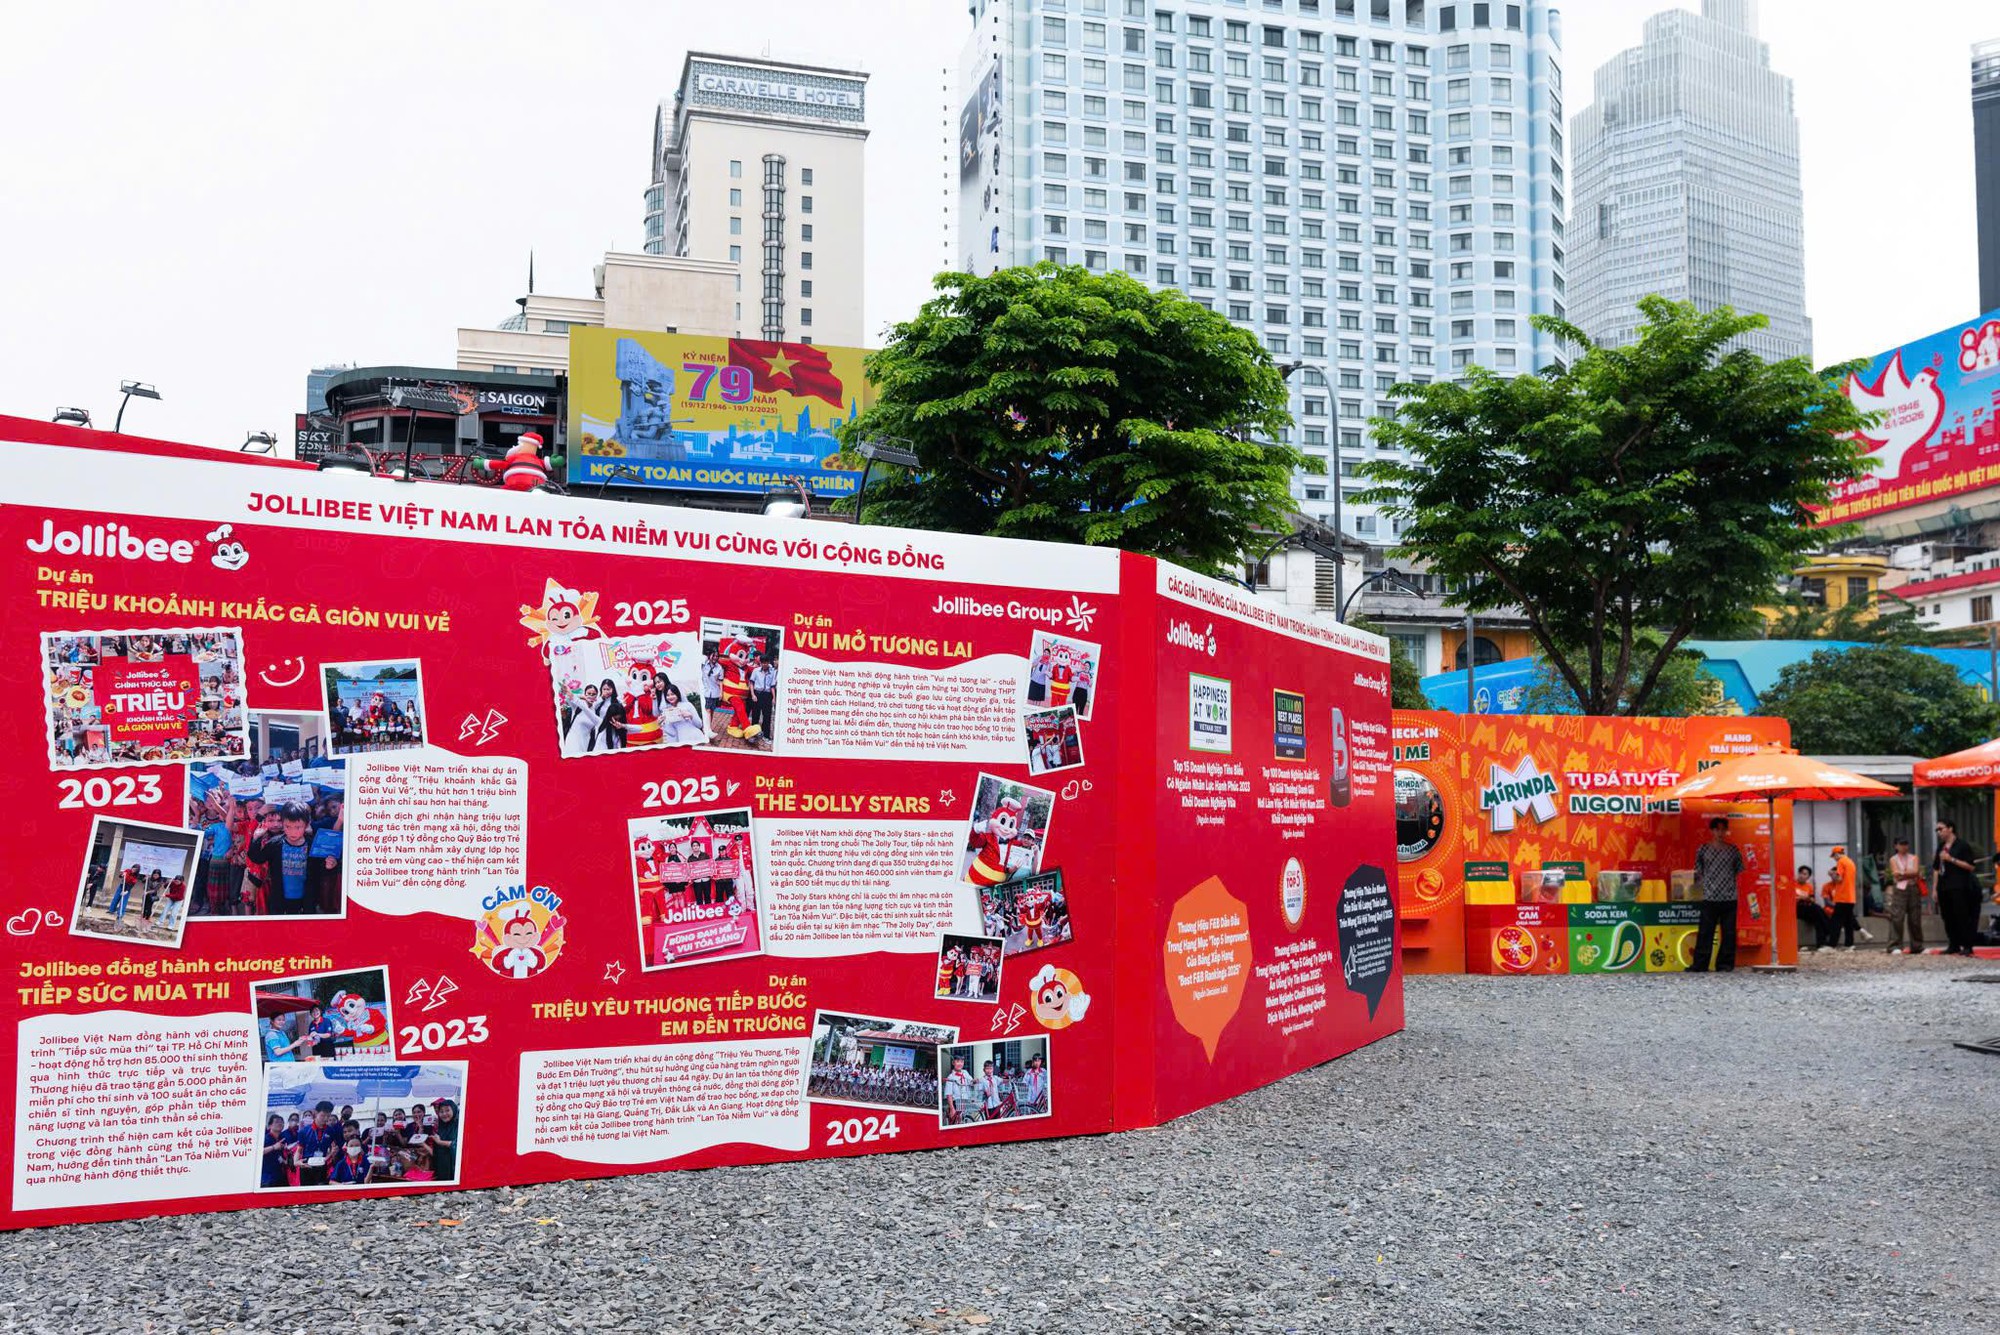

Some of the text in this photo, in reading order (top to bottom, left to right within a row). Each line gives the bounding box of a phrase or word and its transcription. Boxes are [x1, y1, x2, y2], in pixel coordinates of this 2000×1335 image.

[703, 77, 858, 107] CARAVELLE HOTEL
[699, 354, 726, 363] NIỆM
[683, 363, 754, 404] 79
[488, 392, 545, 407] SAIGON
[26, 519, 195, 564] Jollibee
[247, 492, 944, 570] JOLLIBEE VIỆT NAM LAN TỎA NIỀM VUI CÙNG VỚI CỘNG ĐỒNG
[38, 566, 93, 585] Dự án
[36, 588, 450, 632] TRIỆU KHOẢNH KHẮC GÀ GIÒN VUI VẺ
[614, 599, 690, 627] 2025
[932, 595, 1063, 626] Jollibee Group
[1168, 575, 1183, 595] CÁC
[1238, 602, 1264, 622] JOLLIBEE
[1277, 615, 1289, 630] NAM
[794, 613, 832, 628] Dự án
[791, 629, 972, 658] VUI MỞ TƯƠNG LAI
[1167, 618, 1205, 651] Jollibee
[115, 681, 138, 689] CHÍNH
[126, 671, 159, 680] Jollibee
[111, 688, 186, 717] TRIỆU
[1193, 684, 1227, 703] HAPPINESS
[1194, 702, 1202, 718] AT
[155, 722, 169, 730] VUI
[367, 763, 517, 776] Jollibee Việt Nam triển khai dự án
[58, 774, 163, 809] 2023
[641, 775, 720, 808] 2025
[756, 775, 793, 790] Dự án
[755, 793, 930, 813] THE JOLLY STARS
[1570, 795, 1641, 814] NGON
[482, 884, 561, 912] CÁM ƠN
[663, 904, 724, 924] Jollibee
[1518, 912, 1539, 920] CAM
[1584, 910, 1628, 919] SODA KEM
[19, 955, 335, 977] Jollibee đồng hành chương trình
[17, 979, 230, 1005] TIẾP SỨC MÙA THI
[769, 974, 807, 990] Dự án
[531, 991, 807, 1022] TRIỆU YÊU THƯƠNG TIẾP BƯỚC
[400, 1015, 489, 1055] 2023
[661, 1013, 806, 1036] EM ĐẾN TRƯỜNG
[39, 1029, 249, 1045] Jollibee Việt Nam đồng hành với chương
[827, 1114, 900, 1146] 2024
